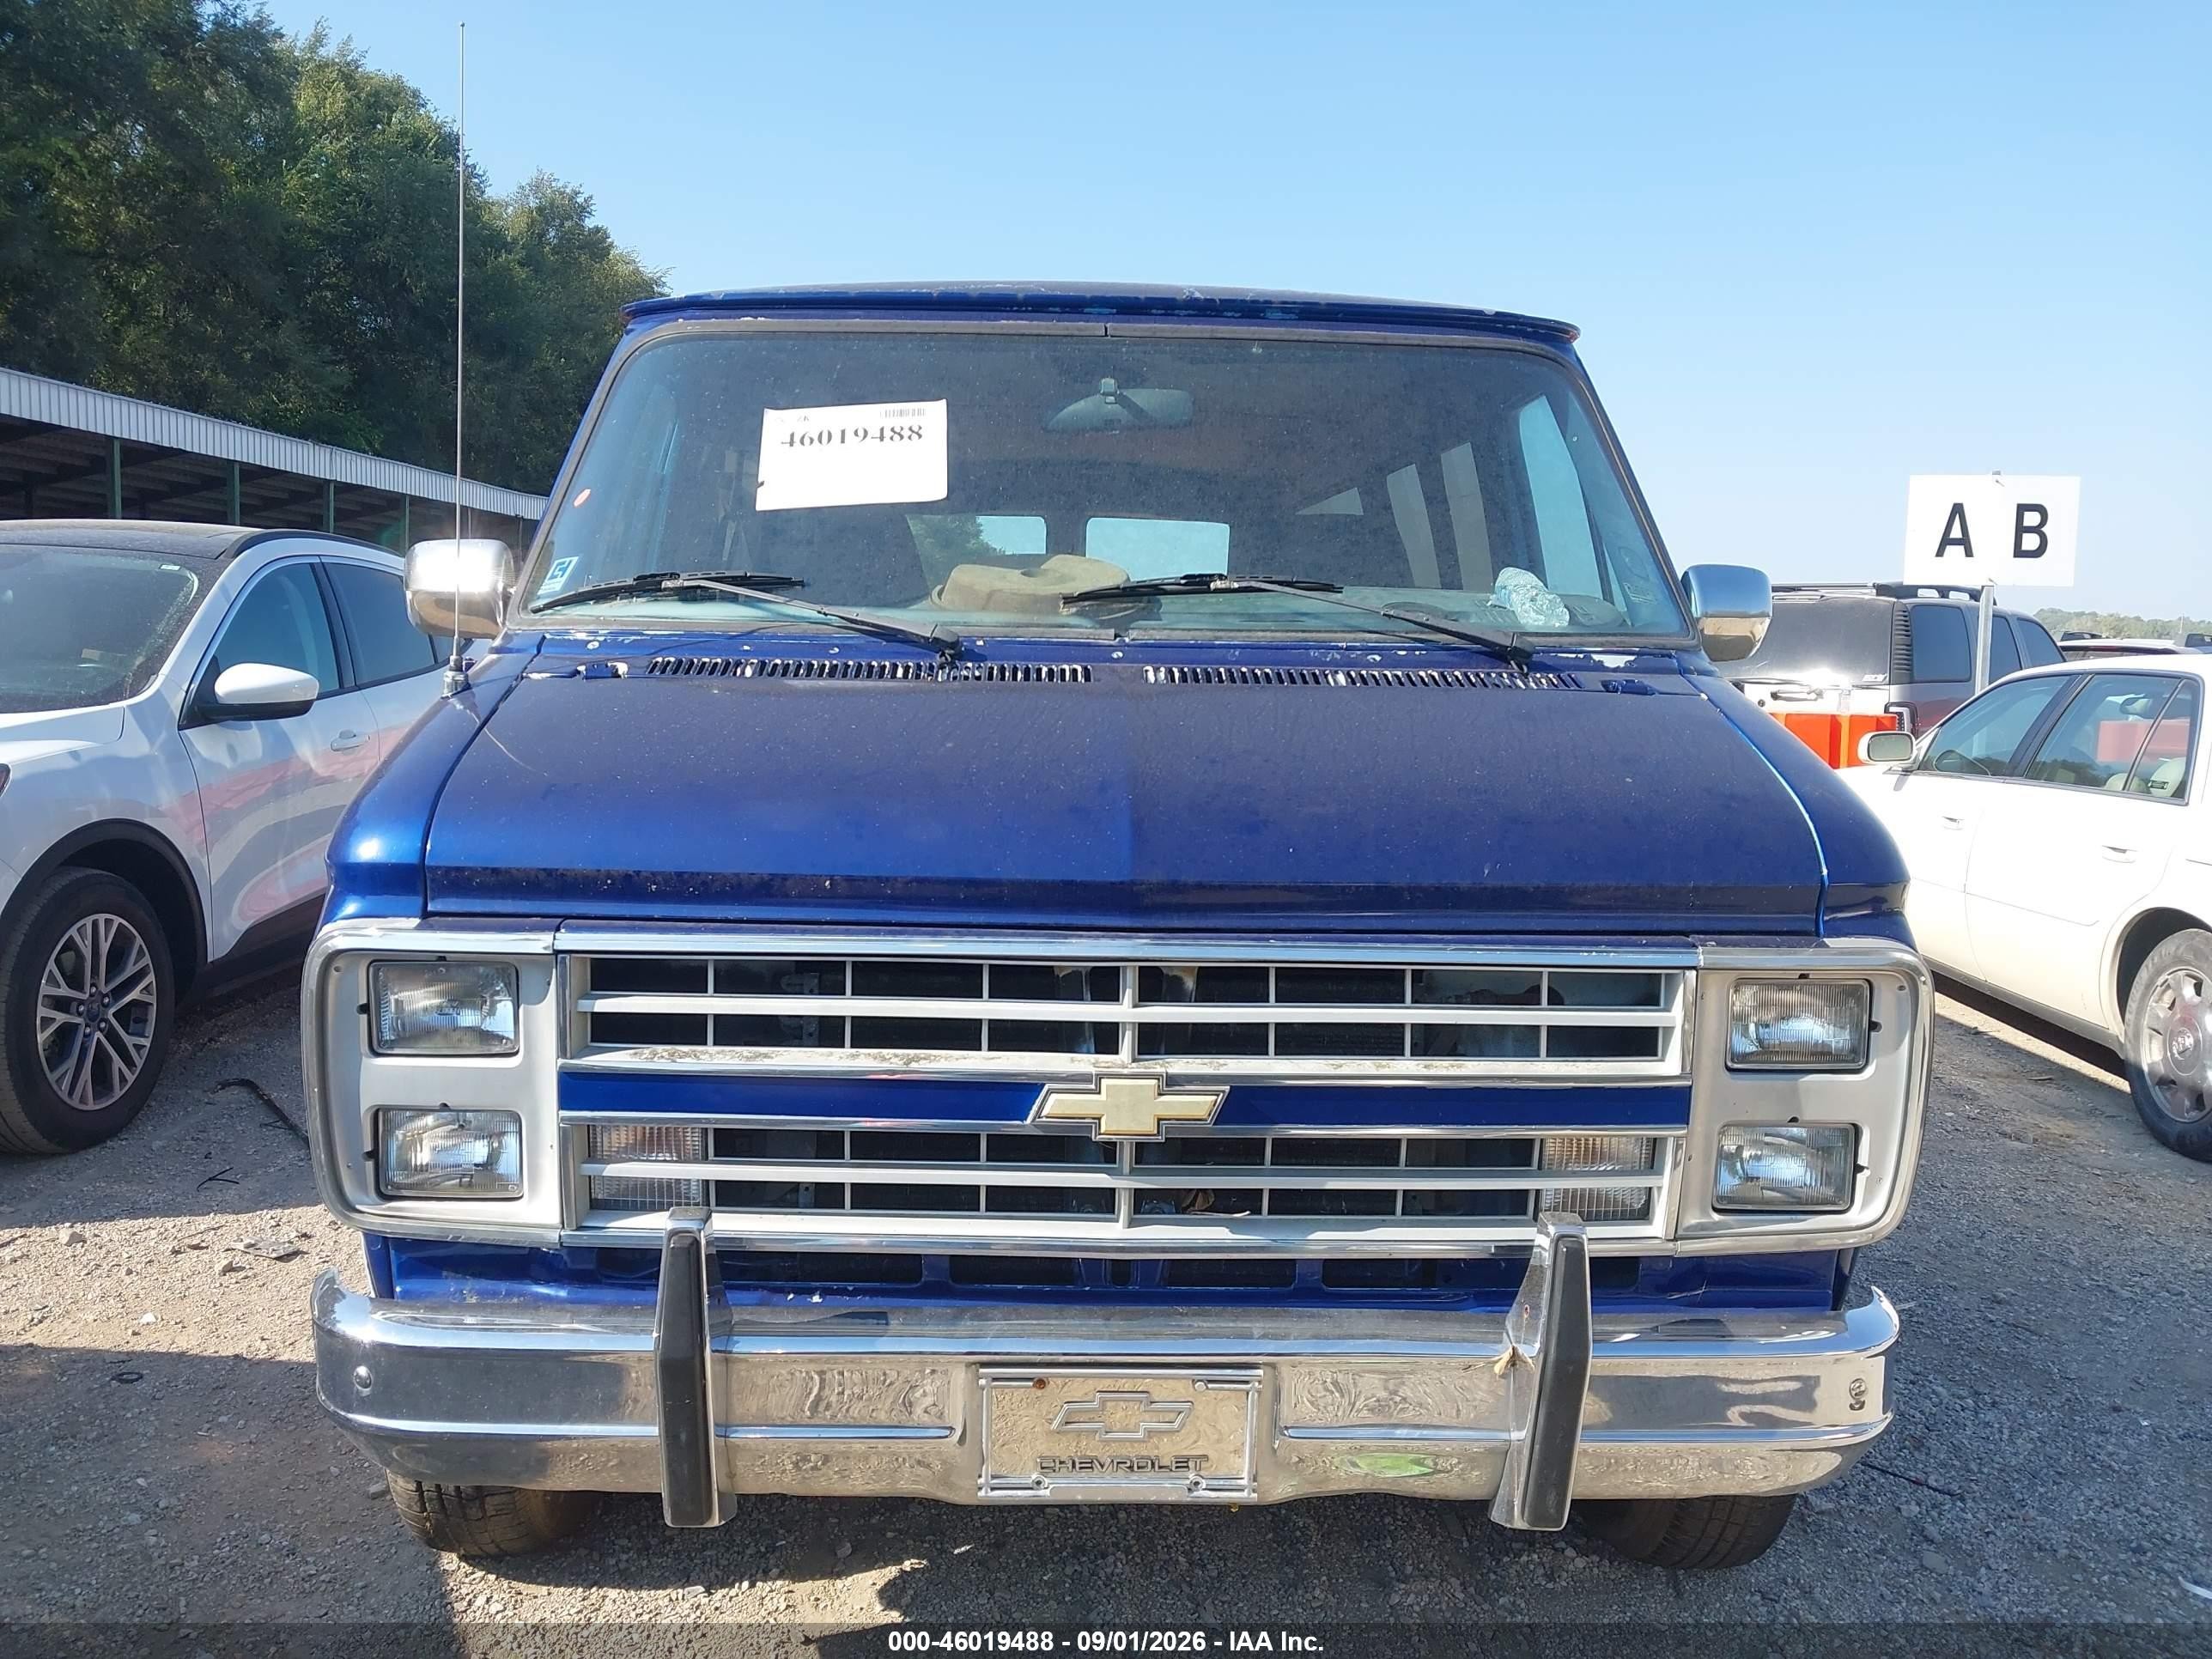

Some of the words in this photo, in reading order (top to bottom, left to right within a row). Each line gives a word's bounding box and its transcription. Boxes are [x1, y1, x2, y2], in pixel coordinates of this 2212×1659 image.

[781, 424, 923, 447] 46019488
[1935, 502, 1974, 557] A
[2013, 503, 2049, 558] B
[1036, 1455, 1209, 1474] CHEVROLET
